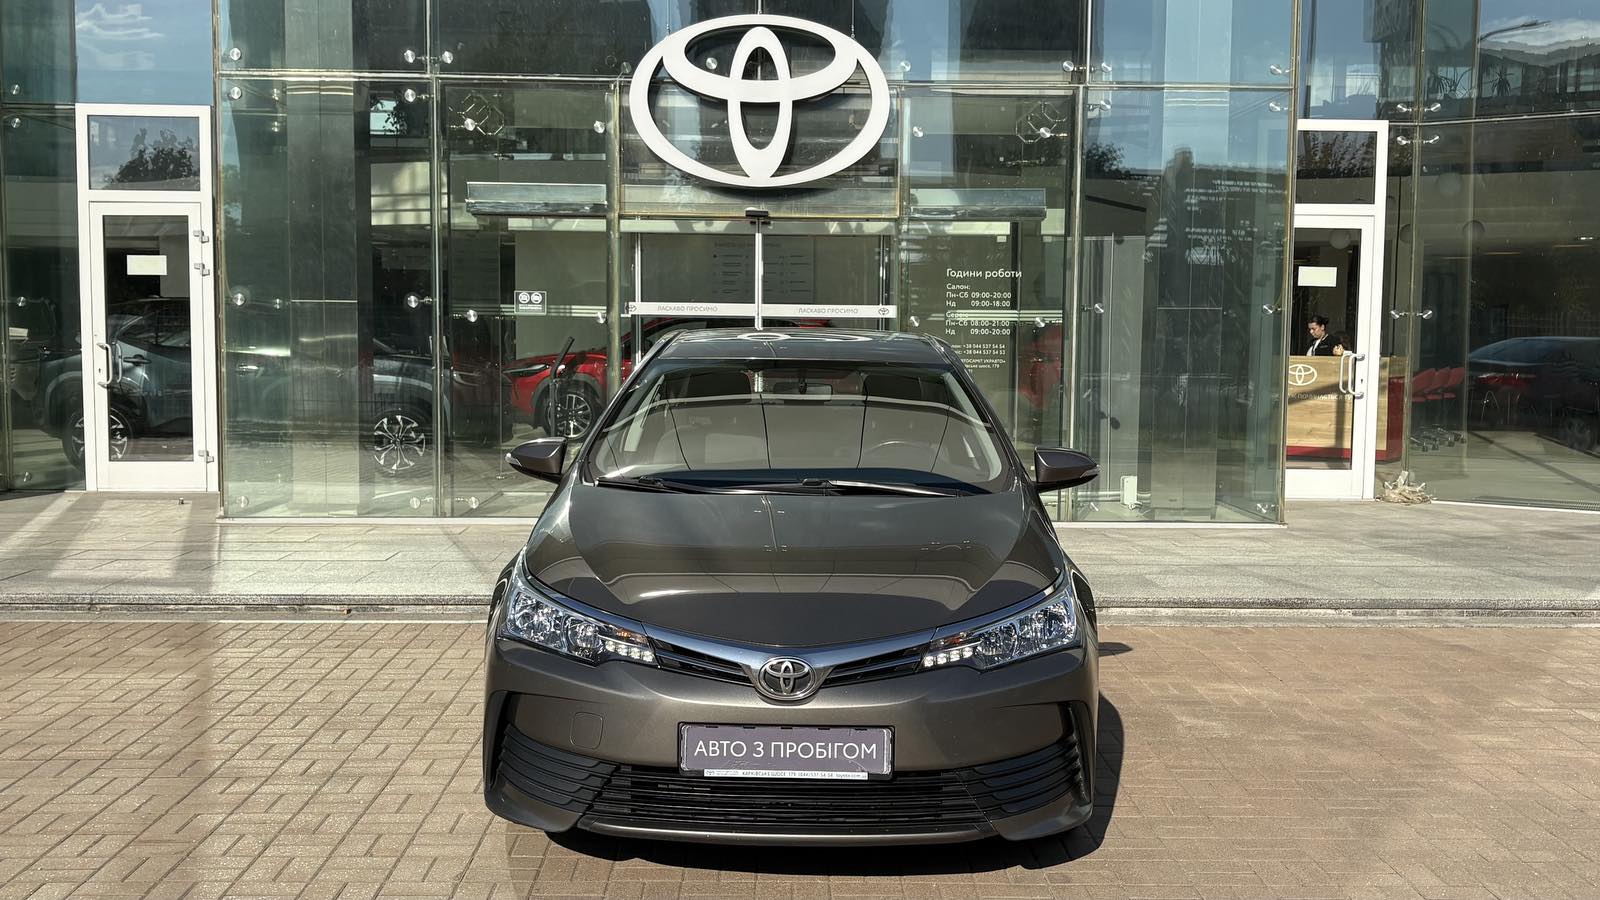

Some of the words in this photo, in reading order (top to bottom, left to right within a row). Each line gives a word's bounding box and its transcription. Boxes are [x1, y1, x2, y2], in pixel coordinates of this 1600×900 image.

[946, 268, 983, 278] Години
[985, 268, 1022, 279] роботи
[694, 740, 747, 757] АВТО
[752, 741, 764, 758] З
[771, 742, 877, 759] ПРОБІГОМ
